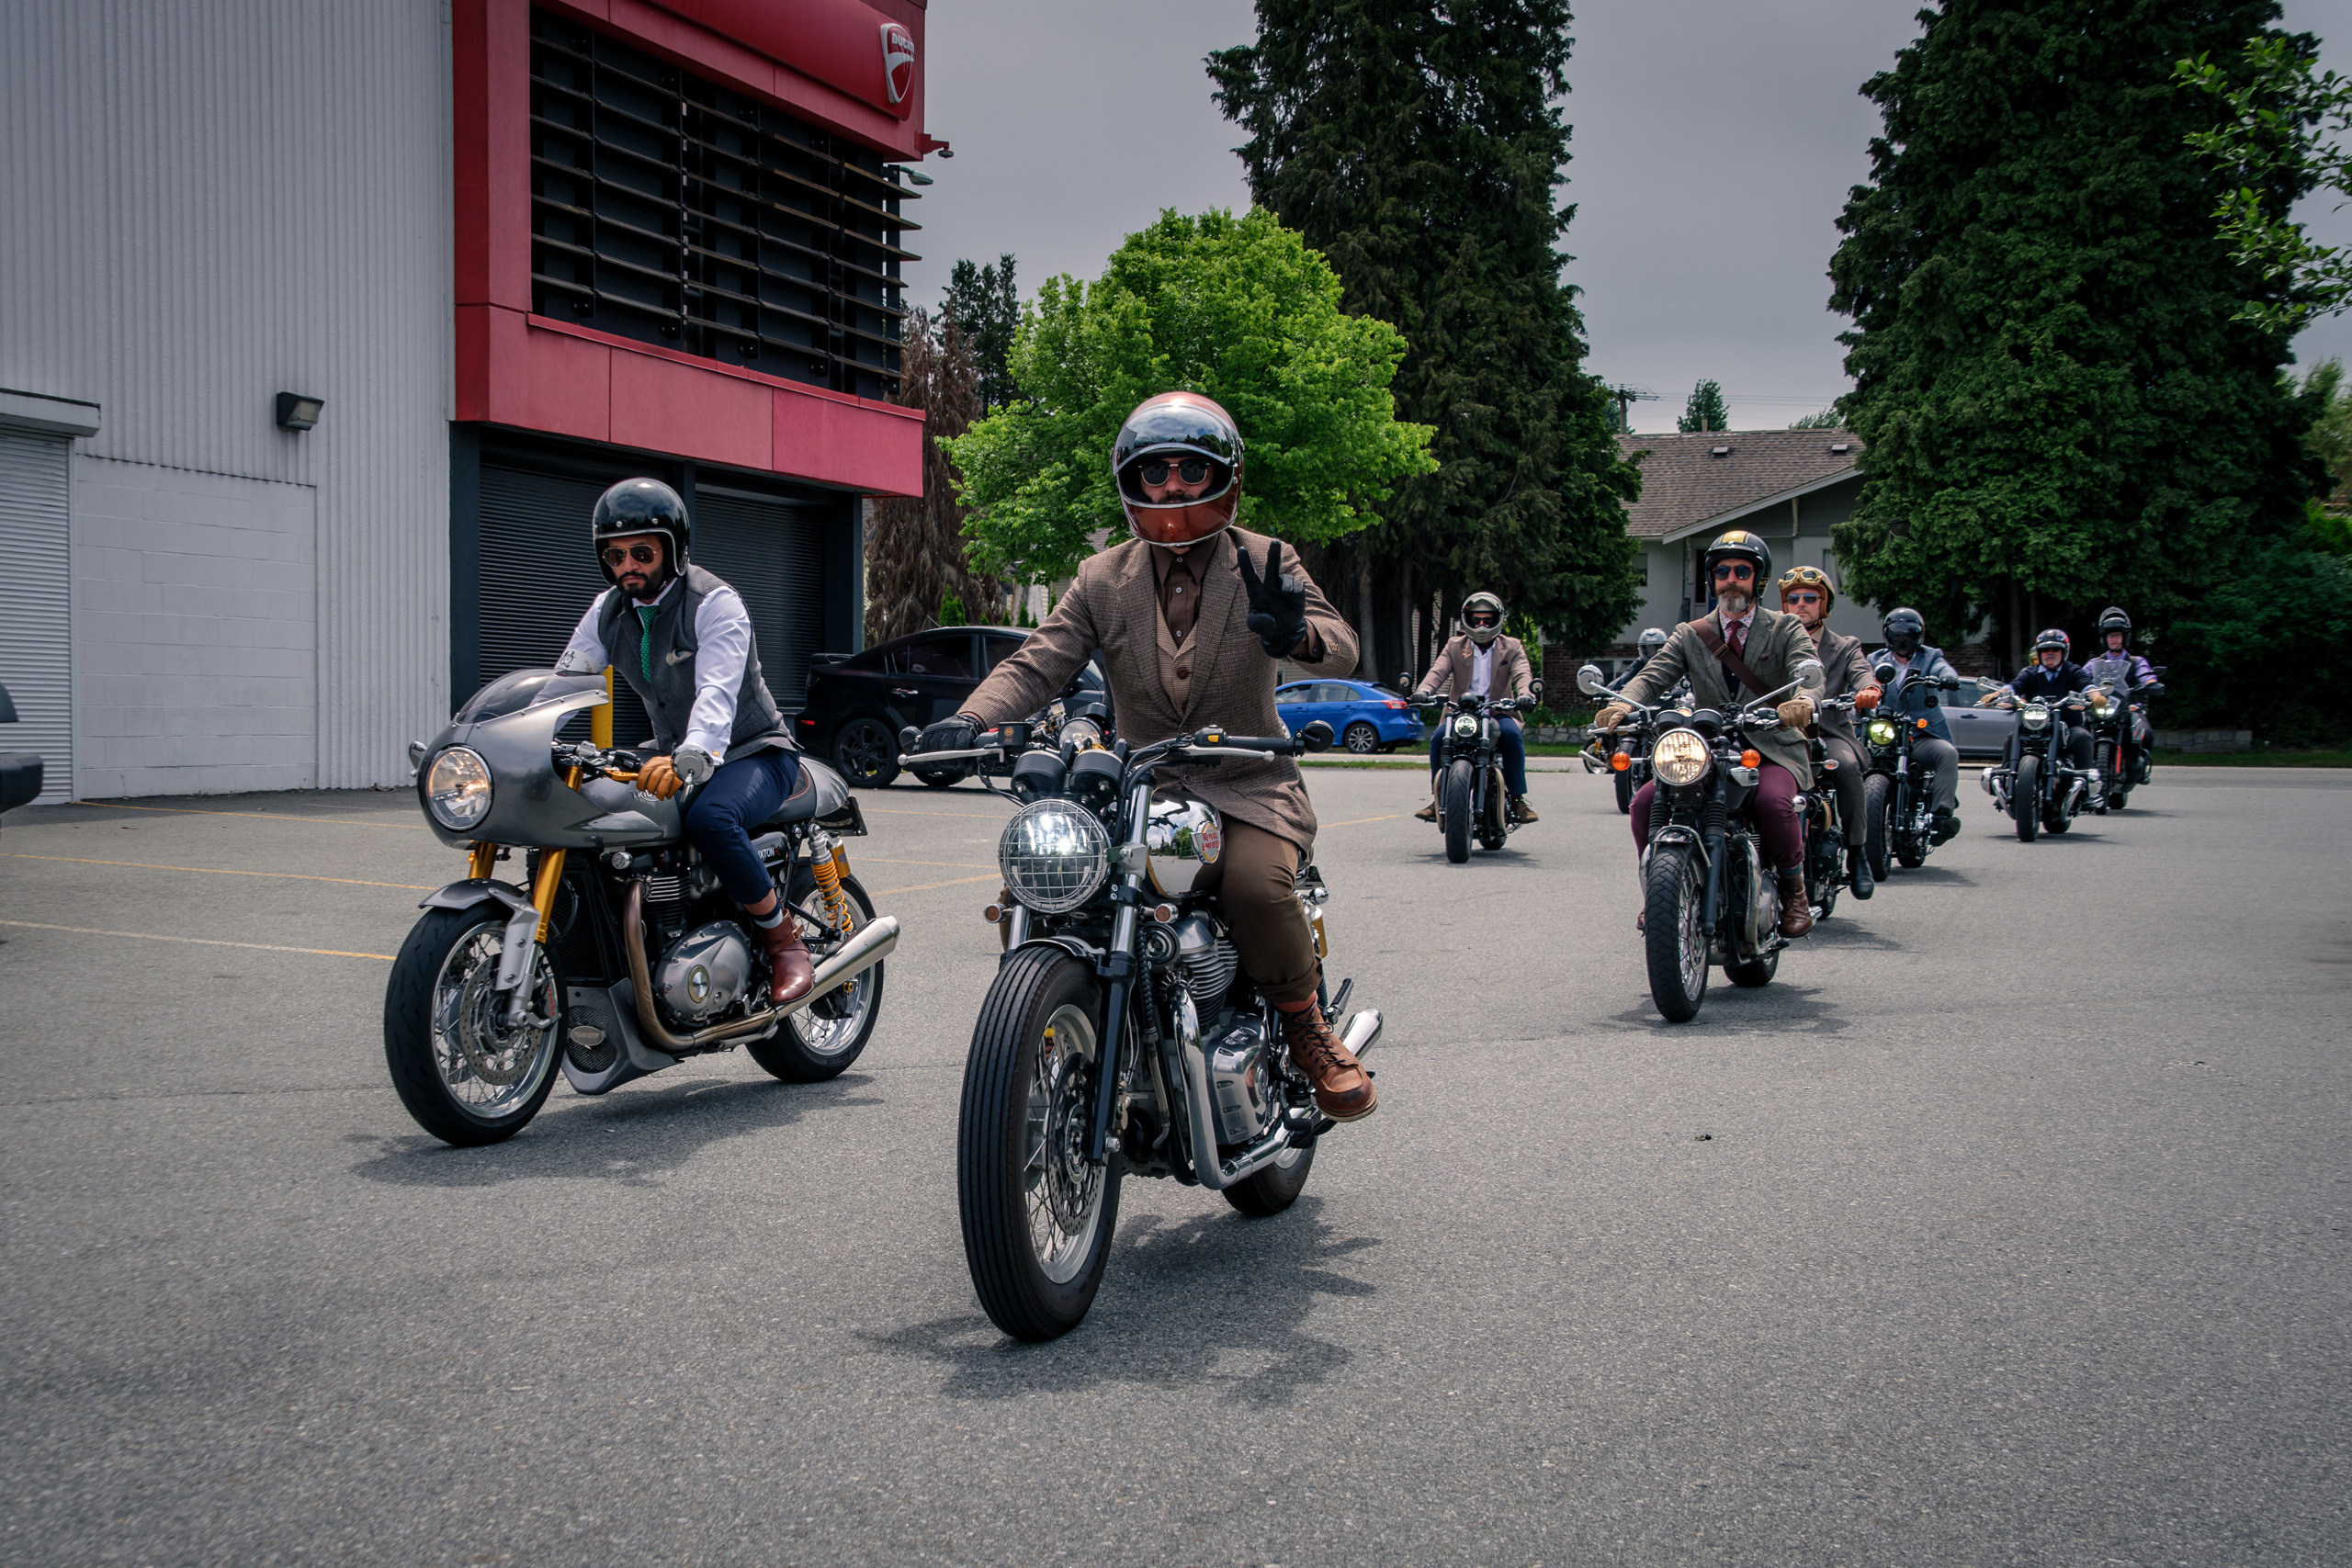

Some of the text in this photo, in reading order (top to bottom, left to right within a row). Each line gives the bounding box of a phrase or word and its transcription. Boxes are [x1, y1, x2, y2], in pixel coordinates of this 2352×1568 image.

[891, 32, 915, 54] DUCATI
[1202, 832, 1218, 841] ROYAL
[1202, 840, 1220, 852] ENFIELD
